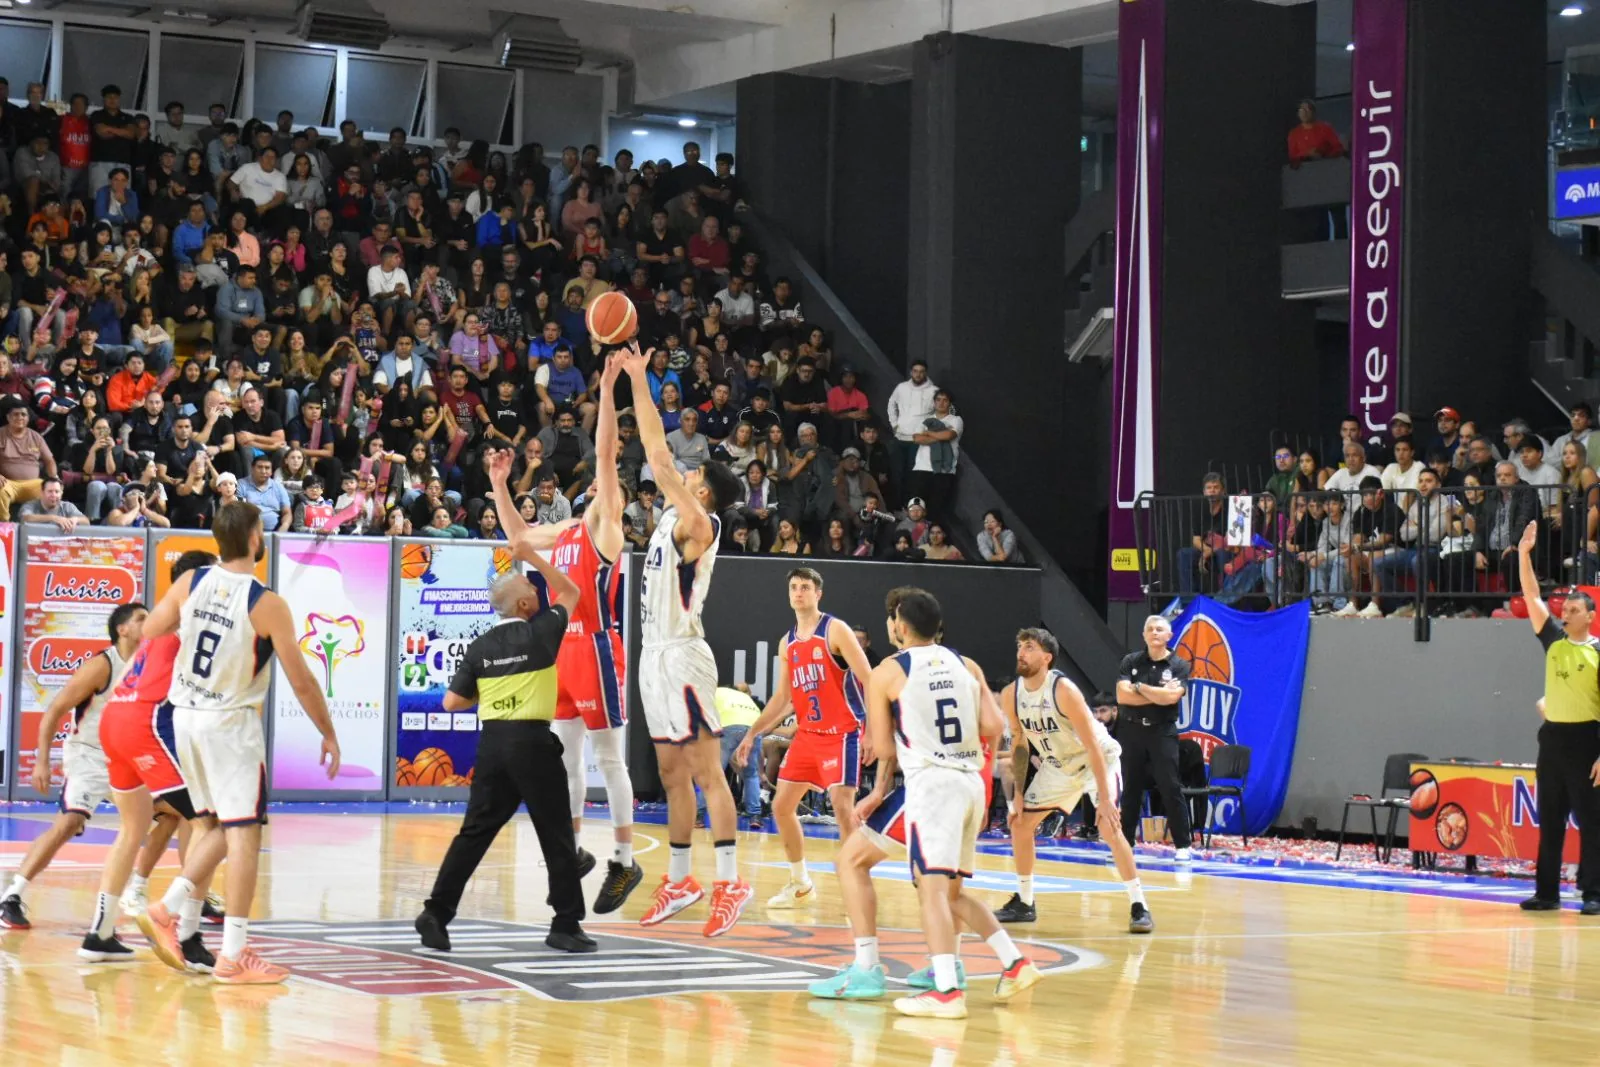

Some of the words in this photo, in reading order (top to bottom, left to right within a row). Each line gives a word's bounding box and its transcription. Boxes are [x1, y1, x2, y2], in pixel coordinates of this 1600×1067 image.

[1360, 79, 1399, 270] seguir
[1365, 286, 1389, 330] a
[44, 570, 123, 601] Luisiño
[191, 629, 222, 679] 8
[928, 680, 954, 692] GAGO
[807, 694, 823, 722] 3
[934, 697, 963, 745] 6
[1020, 716, 1059, 733] VILLA
